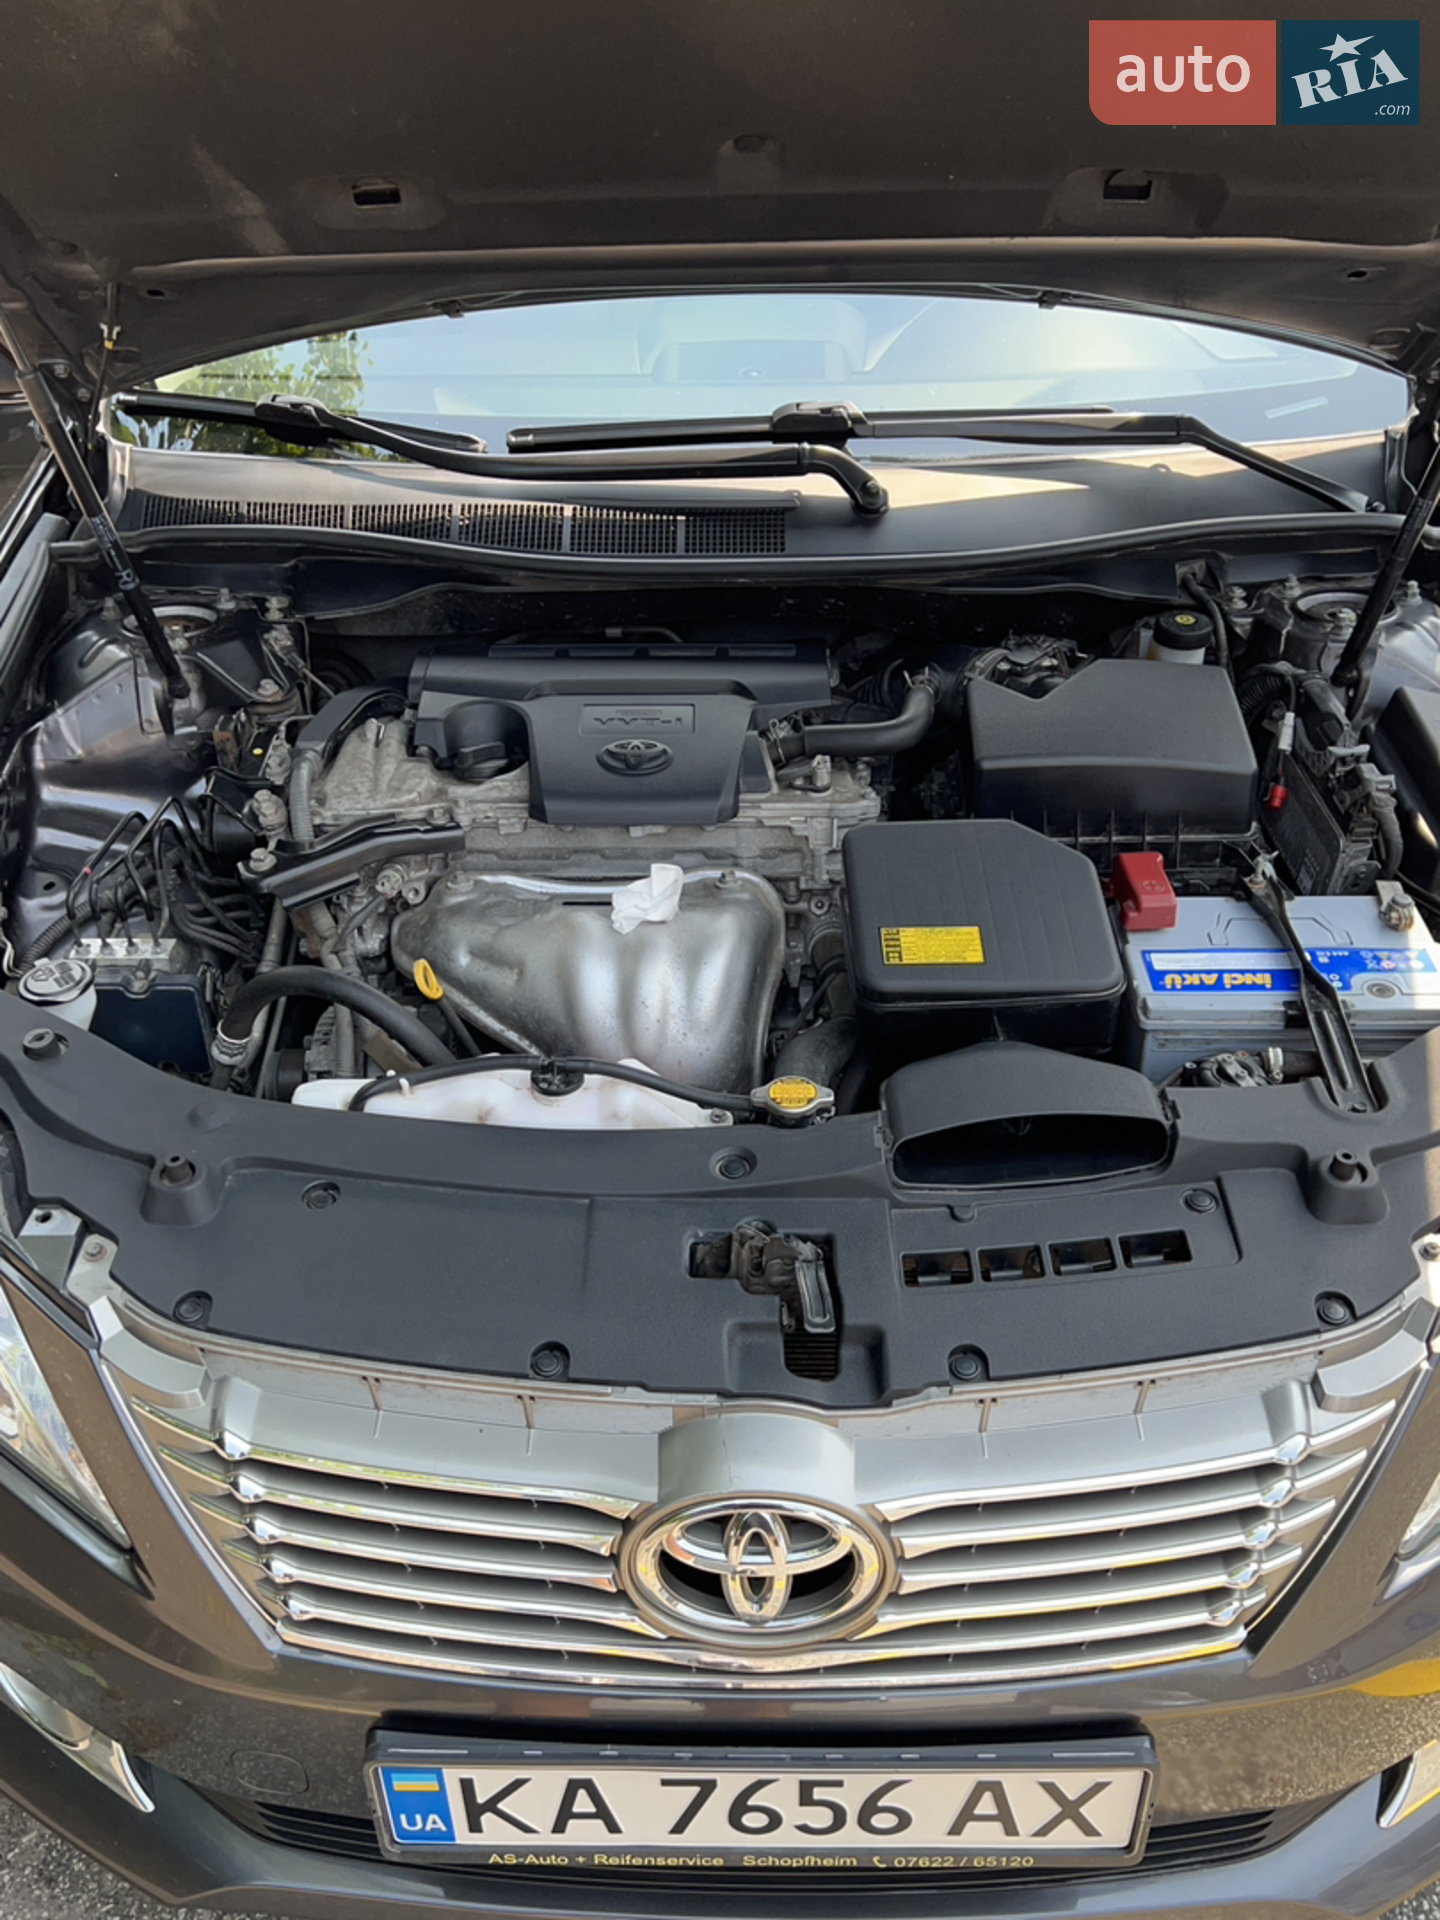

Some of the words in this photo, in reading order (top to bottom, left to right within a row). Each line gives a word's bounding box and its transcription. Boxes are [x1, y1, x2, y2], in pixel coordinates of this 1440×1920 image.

[459, 1777, 623, 1834] KA
[660, 1778, 914, 1836] 7656
[946, 1779, 1114, 1838] AX
[399, 1813, 447, 1832] UA
[488, 1853, 569, 1866] AS-Auto
[593, 1853, 724, 1867] Reifenservice
[742, 1855, 858, 1868] Schopfheim
[893, 1855, 954, 1868] 07622
[973, 1855, 1034, 1868] 65120
